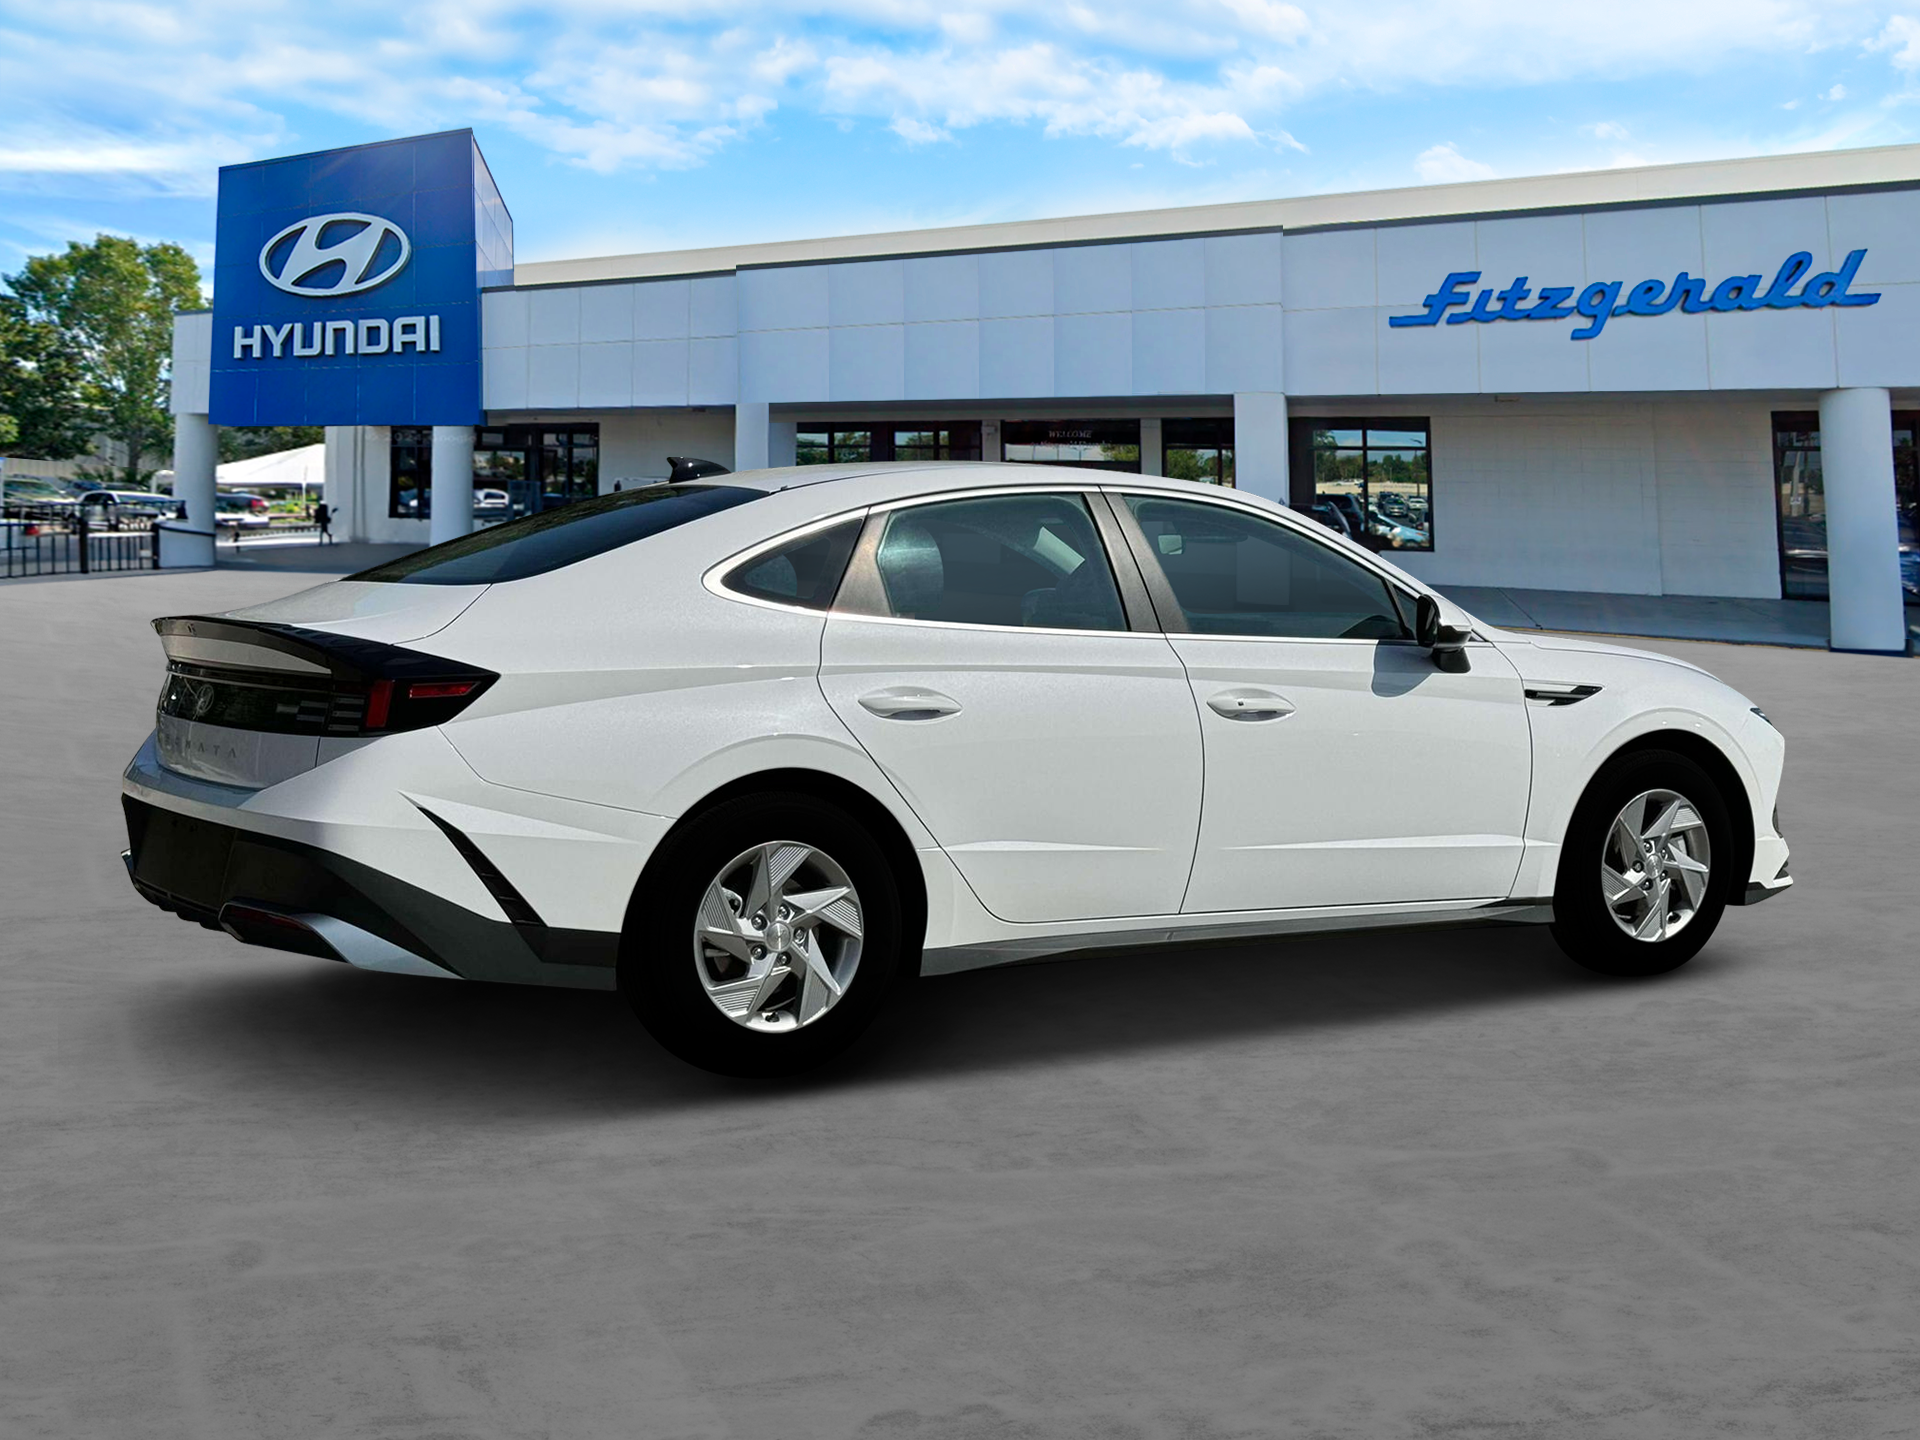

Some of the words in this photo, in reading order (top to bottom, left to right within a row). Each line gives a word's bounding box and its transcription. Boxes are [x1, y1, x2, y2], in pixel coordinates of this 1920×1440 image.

[1389, 249, 1882, 341] Fitzgerald
[234, 315, 440, 358] HYUNDAI
[1048, 430, 1093, 438] WELCOME
